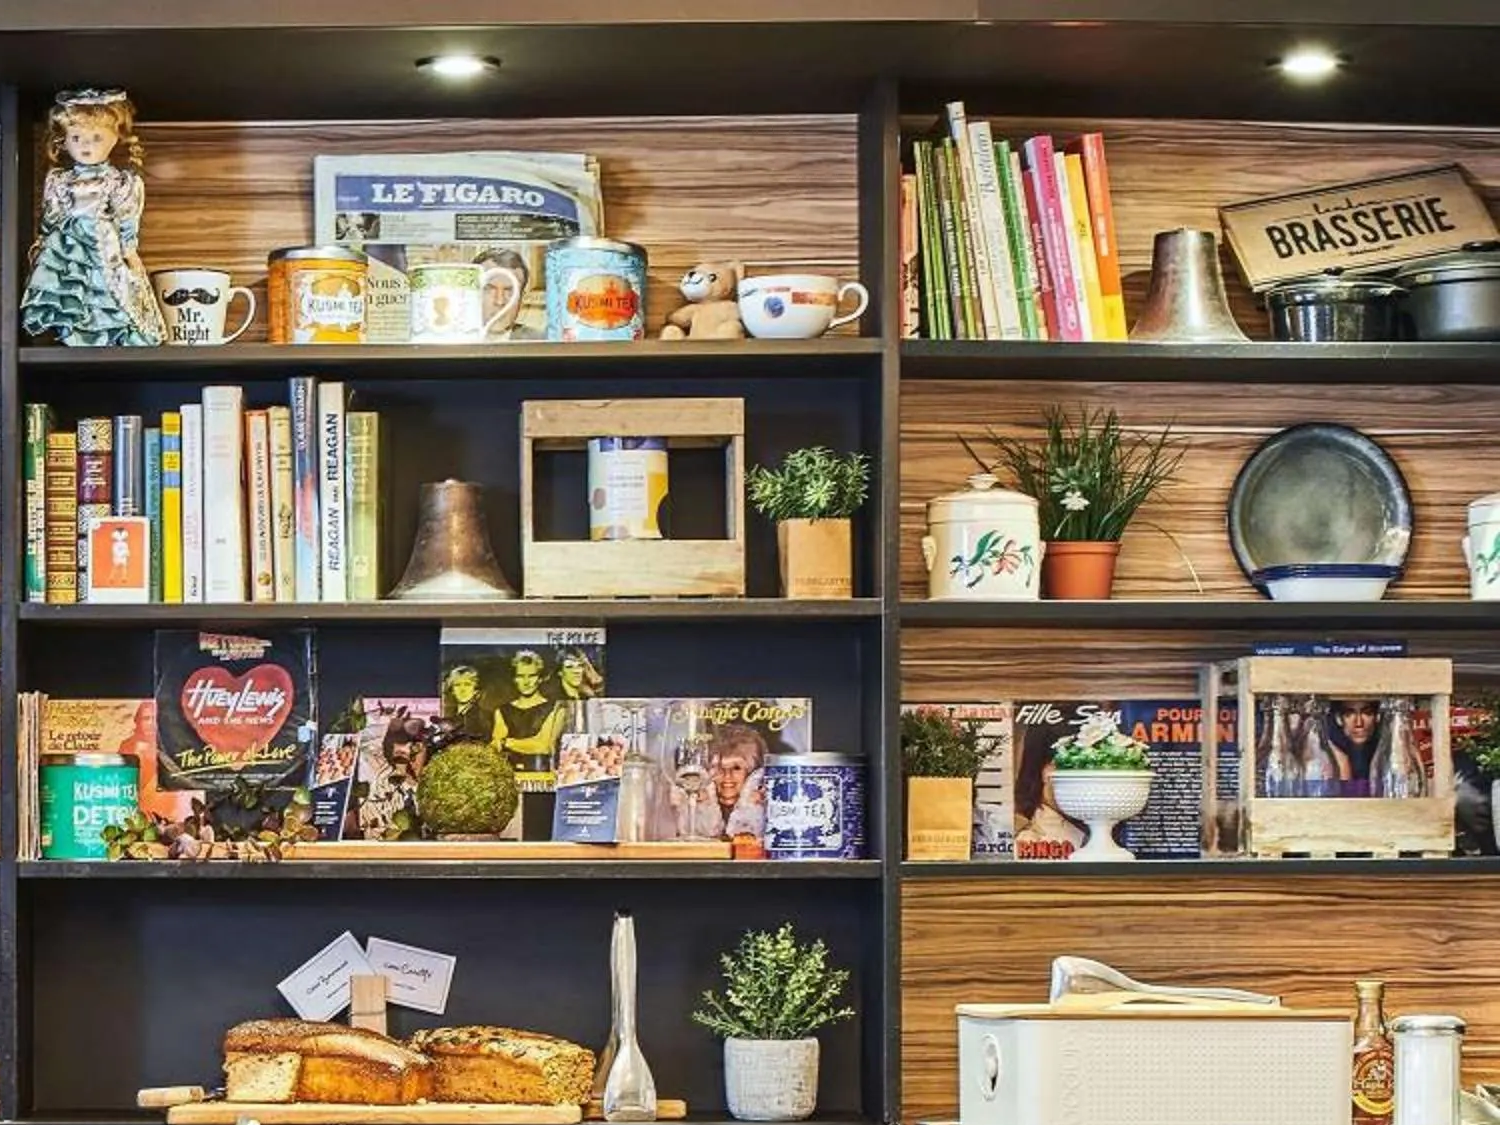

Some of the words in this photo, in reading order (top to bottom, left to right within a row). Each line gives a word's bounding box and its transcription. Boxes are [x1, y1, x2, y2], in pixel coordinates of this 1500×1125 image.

[372, 183, 415, 204] LE
[417, 181, 545, 207] FIGARO
[1265, 197, 1456, 260] BRASSERIE
[176, 307, 205, 323] Mr.
[172, 324, 210, 344] Right
[326, 413, 339, 480] REAGAN
[327, 507, 340, 571] REAGAN
[186, 678, 240, 719] HUEY
[1015, 703, 1064, 725] Fille
[176, 749, 202, 768] The
[263, 743, 297, 761] Love
[73, 781, 120, 801] KUSMI
[803, 803, 828, 819] TEA
[1016, 839, 1075, 861] RINGO
